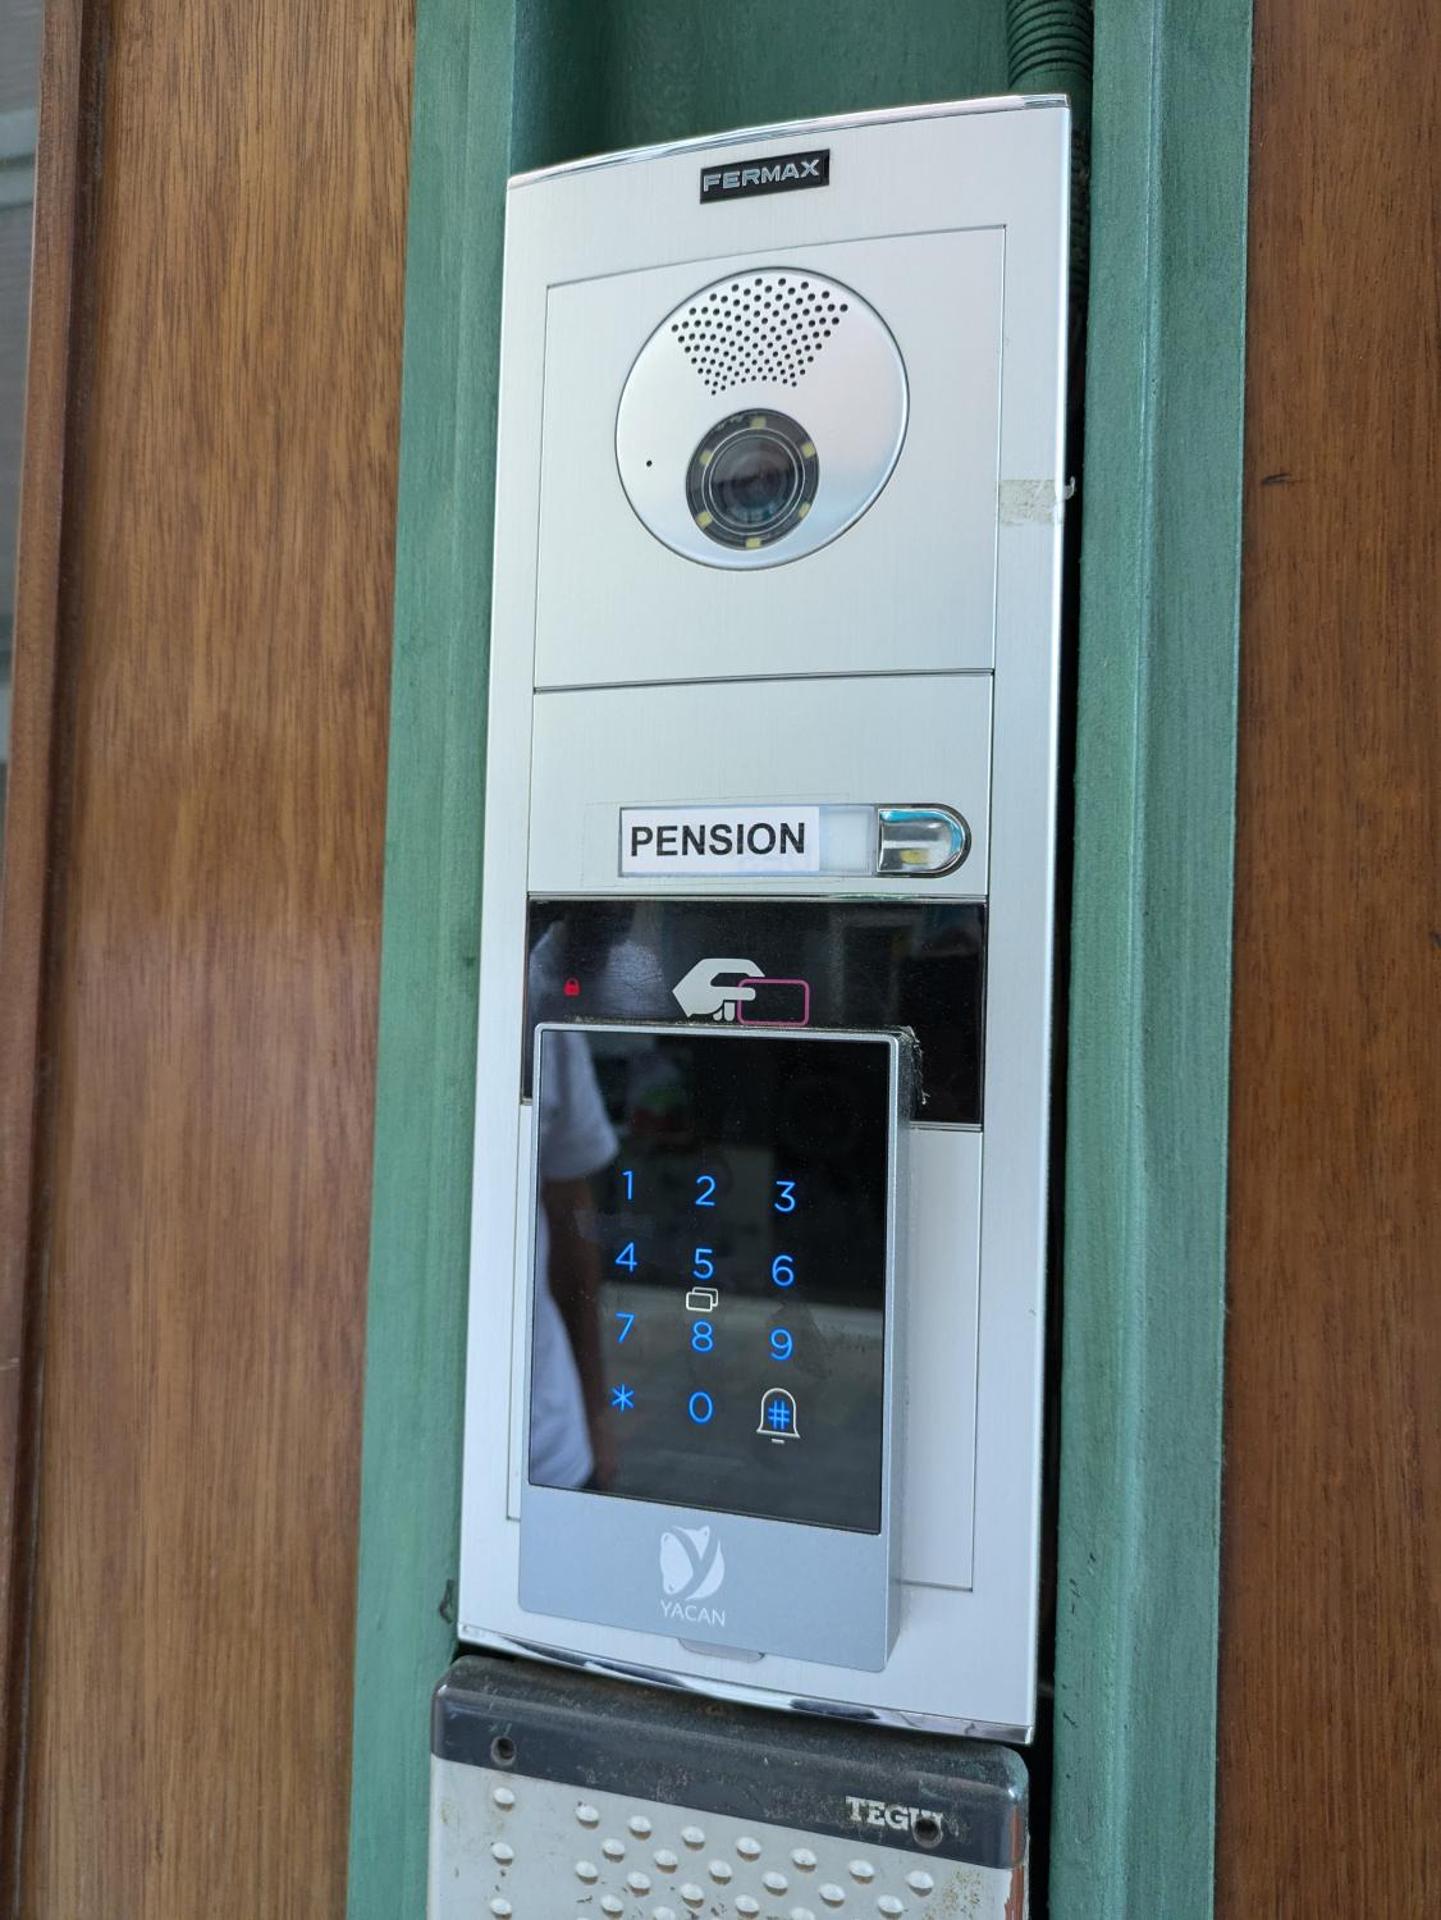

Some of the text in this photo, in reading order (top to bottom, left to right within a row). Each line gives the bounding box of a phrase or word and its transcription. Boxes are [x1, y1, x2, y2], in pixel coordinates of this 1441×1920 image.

[703, 159, 820, 193] FERMAX
[631, 823, 805, 857] PENSION
[622, 1170, 795, 1212] 1 2 3
[615, 1242, 794, 1288] 4 5 6
[616, 1312, 793, 1360] 7 8 9
[689, 1391, 714, 1424] 0
[660, 1599, 726, 1627] YACAN
